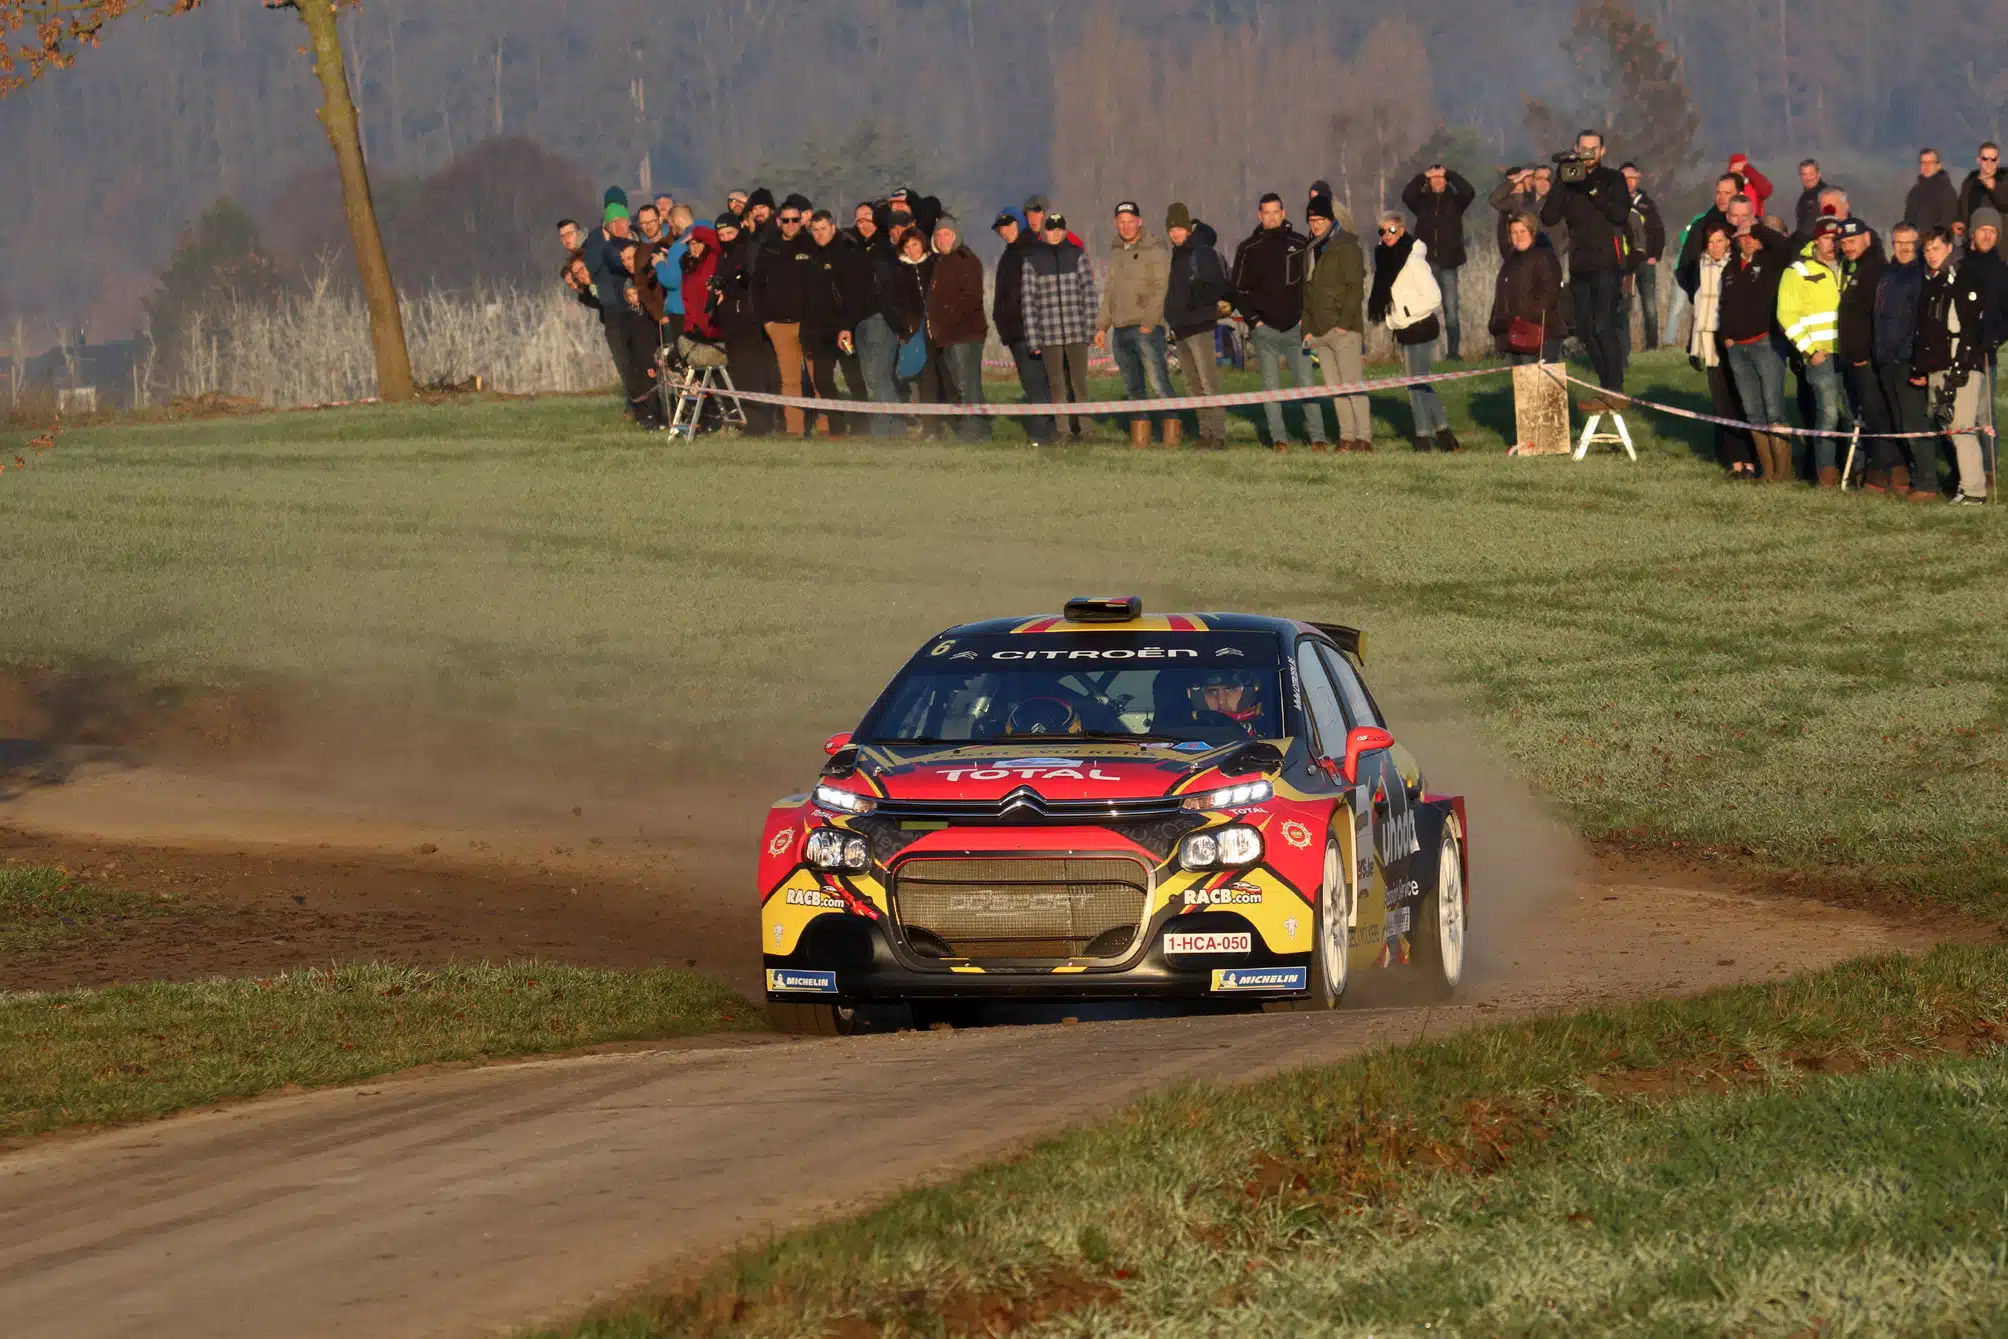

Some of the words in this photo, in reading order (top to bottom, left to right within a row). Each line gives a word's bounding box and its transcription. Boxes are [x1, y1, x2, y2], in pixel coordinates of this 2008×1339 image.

[930, 639, 956, 656] 6
[936, 767, 1121, 783] TOTAL
[811, 809, 834, 819] TOTAL
[1228, 807, 1268, 816] TOTAL
[786, 888, 845, 908] RACB.com
[1184, 888, 1262, 905] RACB.com
[1168, 935, 1248, 951] 1-HCA-050
[786, 976, 829, 987] MICHELIN
[1238, 973, 1298, 985] MICHELIN
